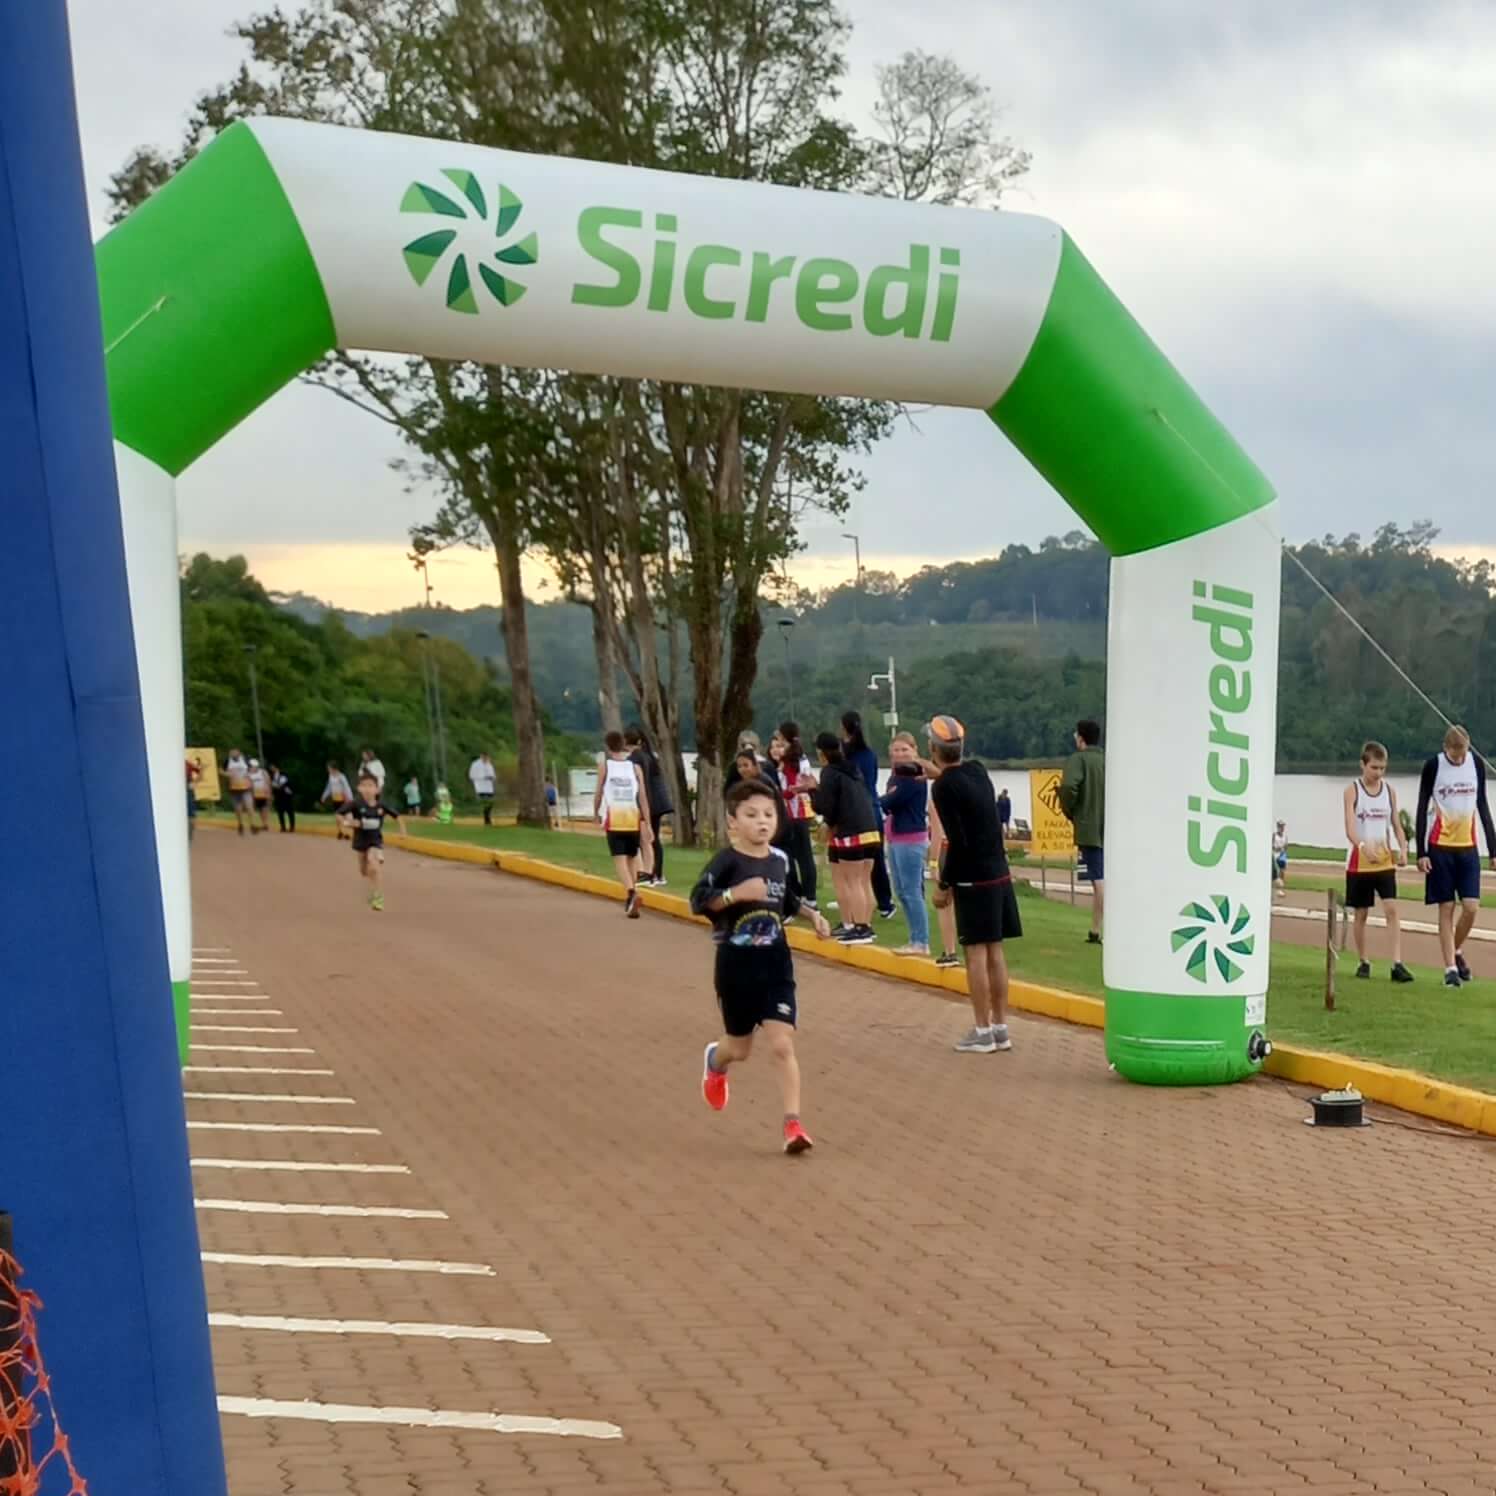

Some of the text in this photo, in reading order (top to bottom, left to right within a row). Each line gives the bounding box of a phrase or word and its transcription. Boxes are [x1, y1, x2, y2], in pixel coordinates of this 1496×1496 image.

[571, 204, 960, 342] Sicredi
[1188, 579, 1254, 874] Sicredi
[1037, 831, 1073, 840] ELEVAD
[1044, 820, 1070, 828] FAIXA
